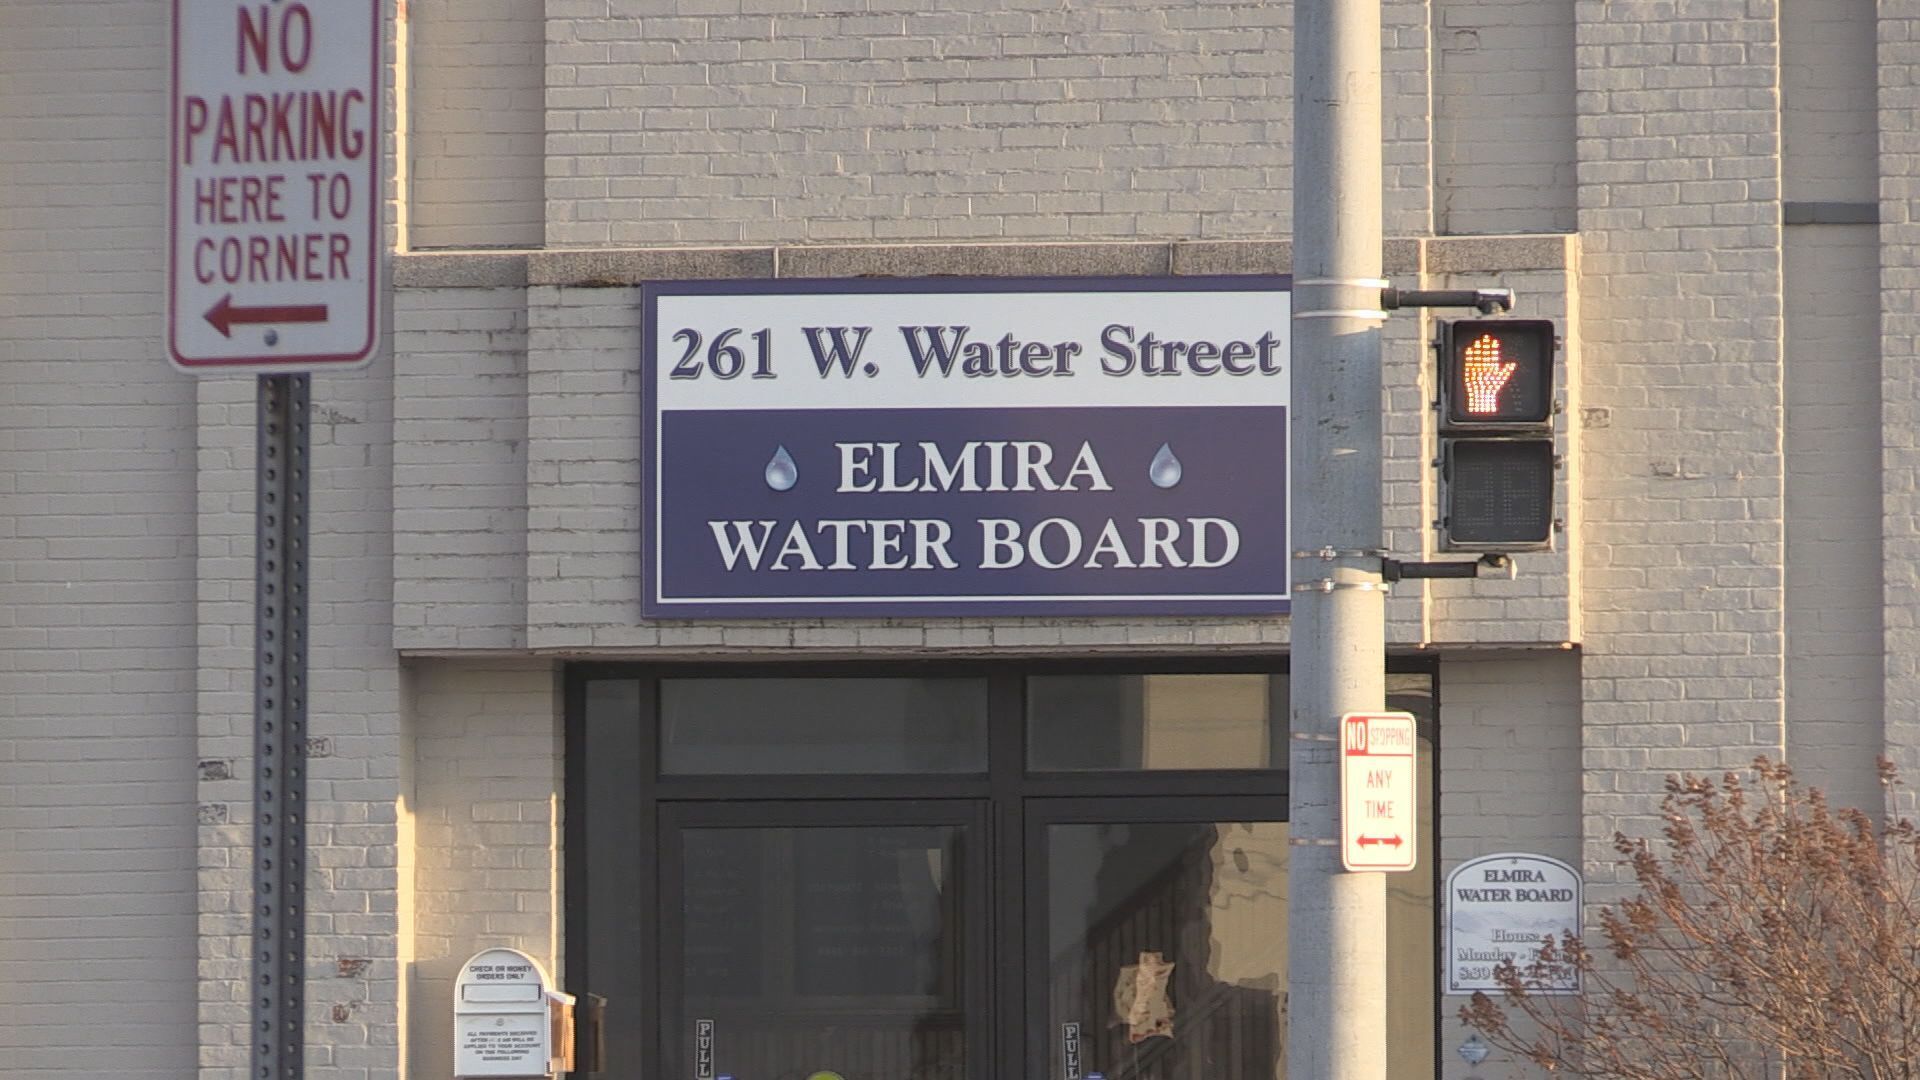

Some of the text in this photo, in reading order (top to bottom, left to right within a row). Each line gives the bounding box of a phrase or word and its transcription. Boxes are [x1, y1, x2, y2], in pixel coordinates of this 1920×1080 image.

[237, 3, 312, 75] NO
[183, 88, 365, 164] PARKING
[195, 172, 350, 224] HERE TO
[194, 233, 350, 284] CORNER
[669, 323, 1282, 380] 261 W. Water Street
[834, 440, 1114, 493] ELMIRA
[707, 517, 1241, 571] WATER BOARD
[1346, 722, 1411, 750] NO STOPPING
[1366, 770, 1393, 788] ANY
[1364, 800, 1395, 819] TIME
[1457, 888, 1574, 902] WATER BOARD
[1484, 869, 1546, 882] ELMIRA
[469, 965, 493, 973] CHECK
[495, 965, 505, 973] OR
[1457, 947, 1518, 962] Monday
[699, 1022, 711, 1077] PULL
[1065, 1026, 1079, 1080] PULL
